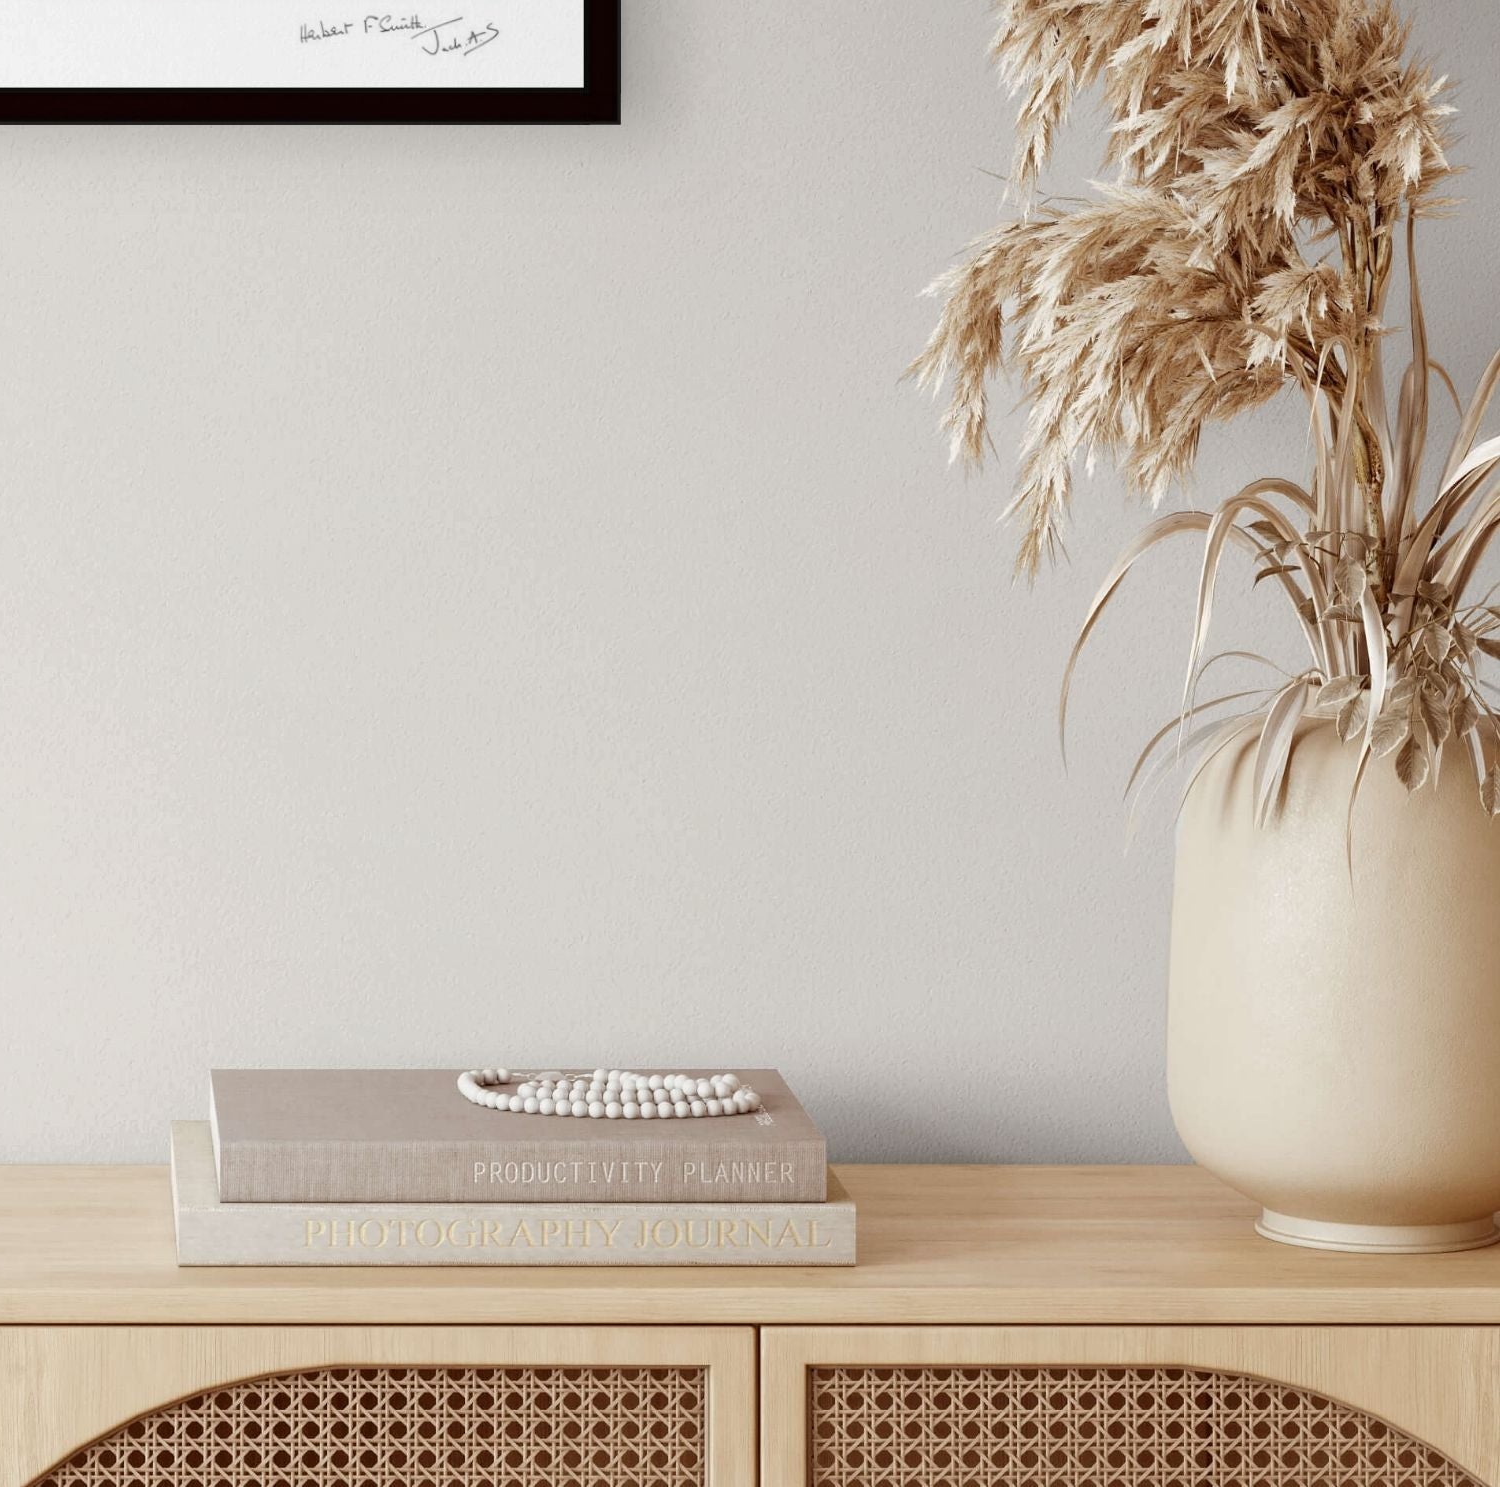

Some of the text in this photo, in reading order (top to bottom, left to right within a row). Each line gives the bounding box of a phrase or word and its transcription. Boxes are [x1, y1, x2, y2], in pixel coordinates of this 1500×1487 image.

[473, 1161, 795, 1183] PRODUCTIVITY PLANNER
[303, 1218, 832, 1249] PHOTOGRAPHY JOURNAL
